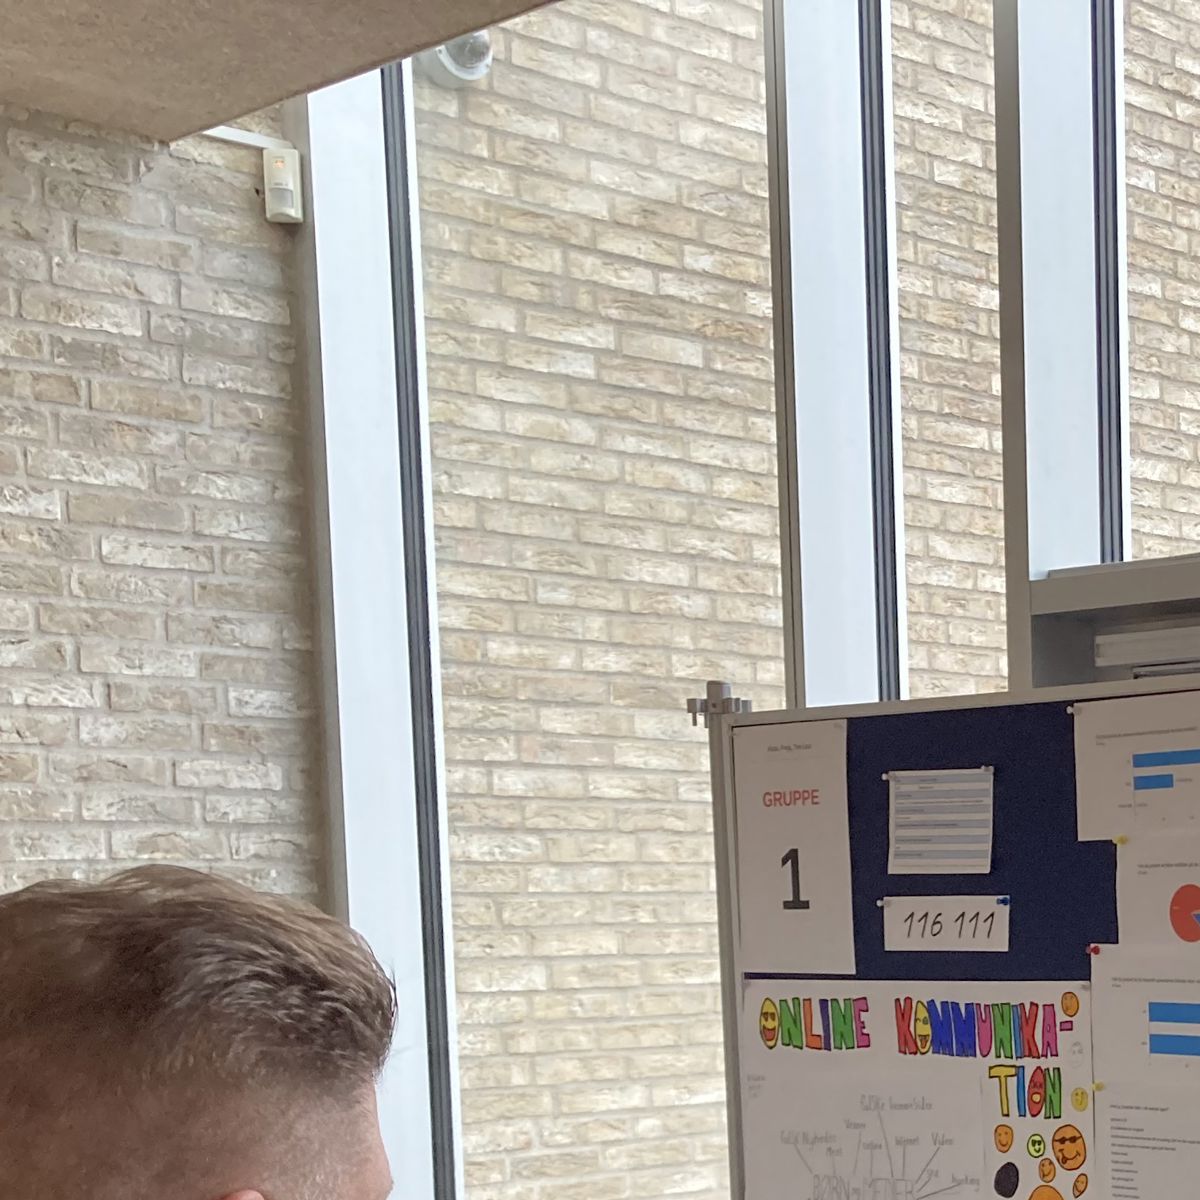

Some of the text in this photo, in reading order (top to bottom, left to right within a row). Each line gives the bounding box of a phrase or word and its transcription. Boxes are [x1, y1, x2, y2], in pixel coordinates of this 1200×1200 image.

[763, 789, 820, 807] GRUPPE
[780, 847, 810, 910] 1
[903, 911, 996, 939] 116 111
[759, 997, 871, 1051] ONLINE
[894, 996, 1074, 1059] KOMMUNIKA-
[988, 1065, 1062, 1120] TION
